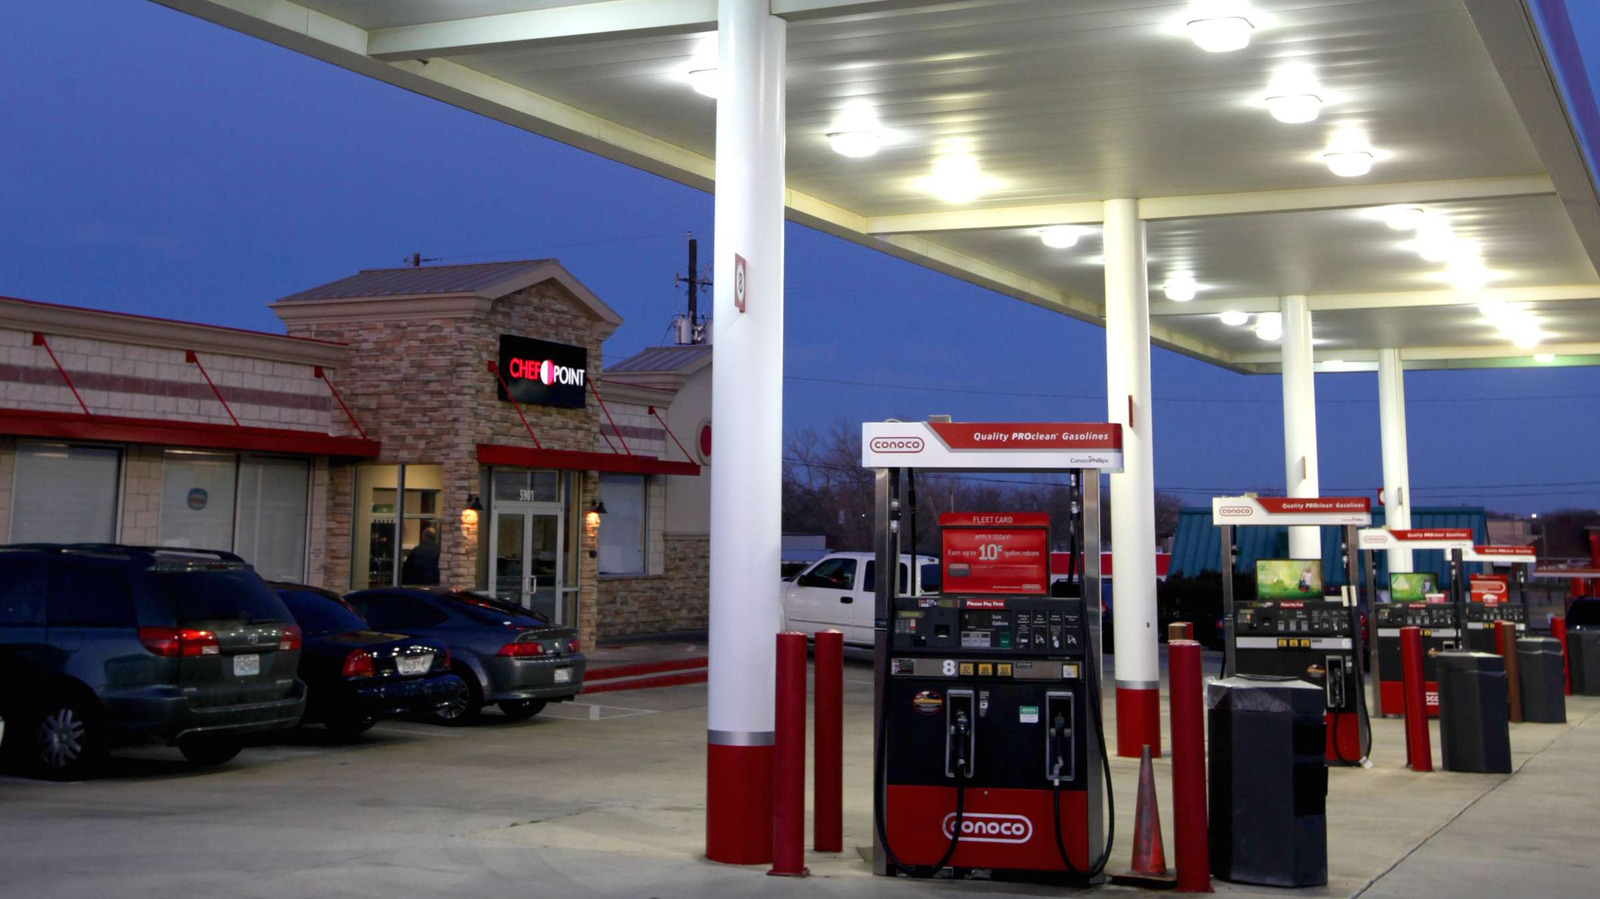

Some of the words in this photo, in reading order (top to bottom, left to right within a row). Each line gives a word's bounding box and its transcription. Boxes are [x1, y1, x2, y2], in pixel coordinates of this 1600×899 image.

[509, 357, 542, 380] CHEF
[554, 365, 585, 386] POINT
[973, 432, 1009, 442] Quality
[1061, 431, 1109, 441] Gasolines
[874, 440, 920, 449] conoco
[1070, 457, 1109, 465] ConocoPhillips
[943, 659, 956, 676] 8
